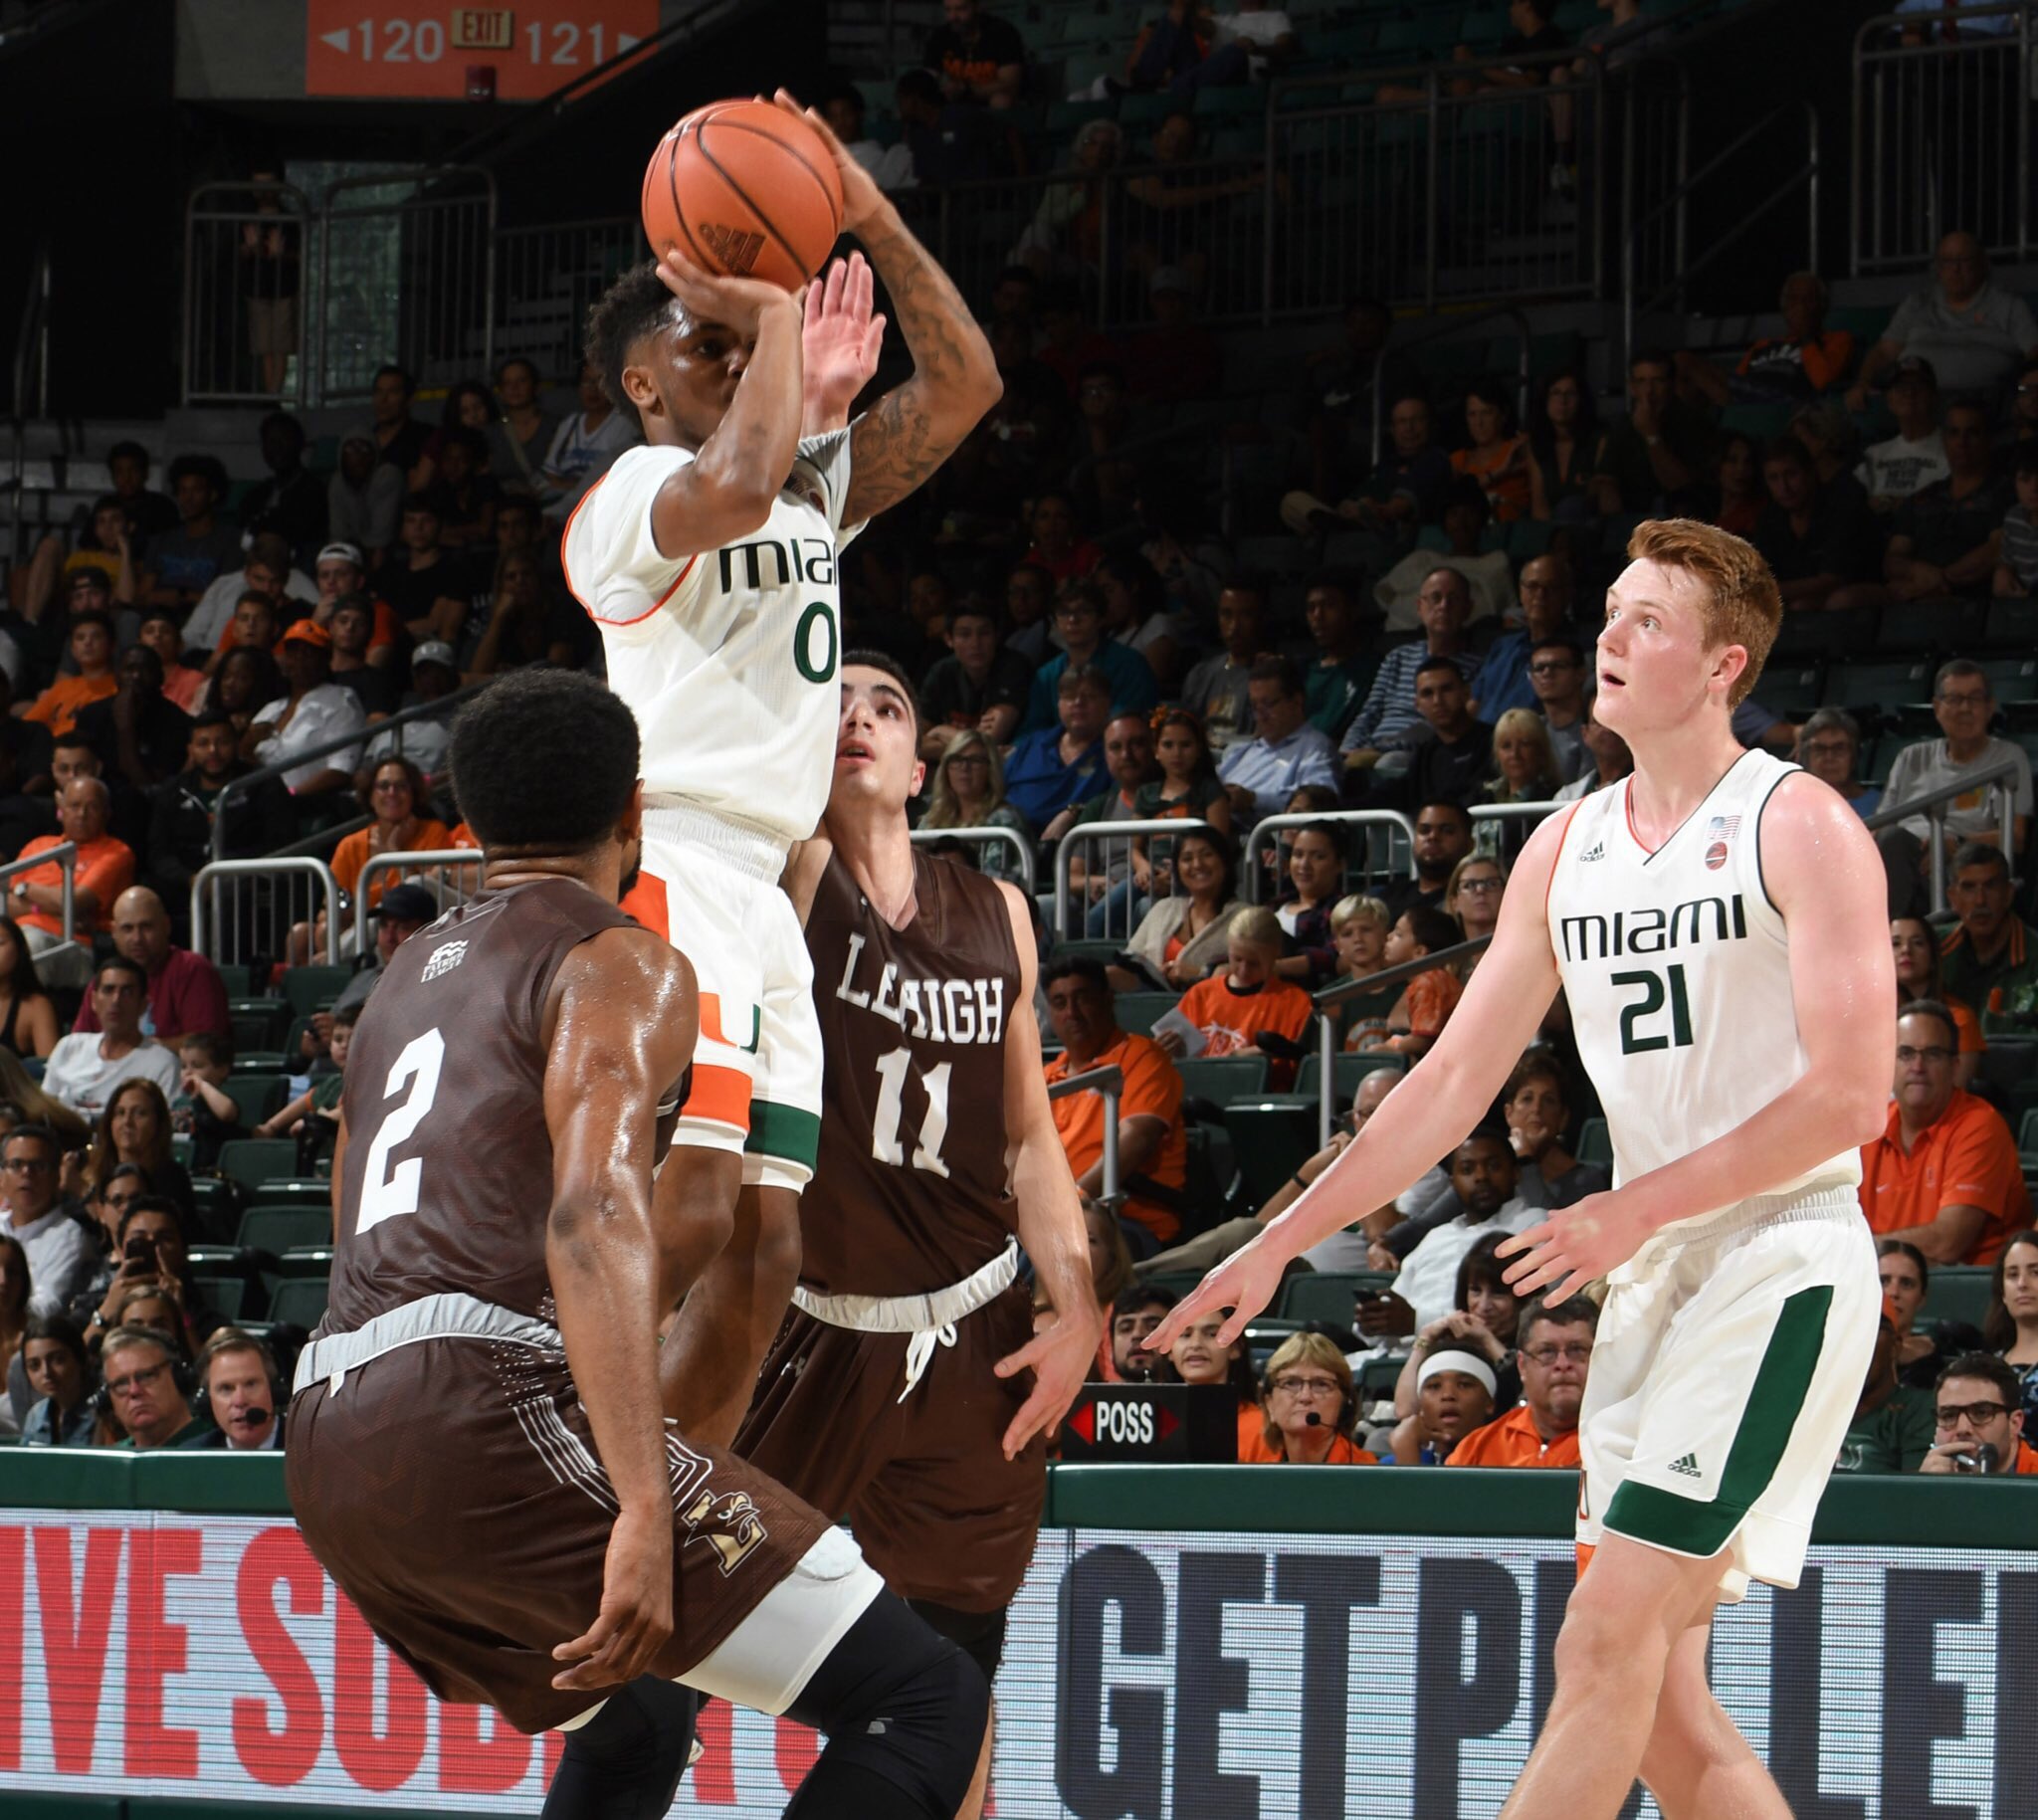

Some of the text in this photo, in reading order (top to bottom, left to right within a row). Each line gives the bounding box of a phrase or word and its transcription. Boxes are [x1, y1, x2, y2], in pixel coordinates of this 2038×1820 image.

[357, 19, 604, 66] 120 121
[461, 12, 504, 42] EXIT
[793, 601, 838, 685] 0
[1610, 963, 1694, 1055] 21
[355, 1026, 446, 1235] 2
[872, 1046, 952, 1179] 11
[1096, 1400, 1154, 1444] POSS
[1055, 1544, 1381, 1820] GET
